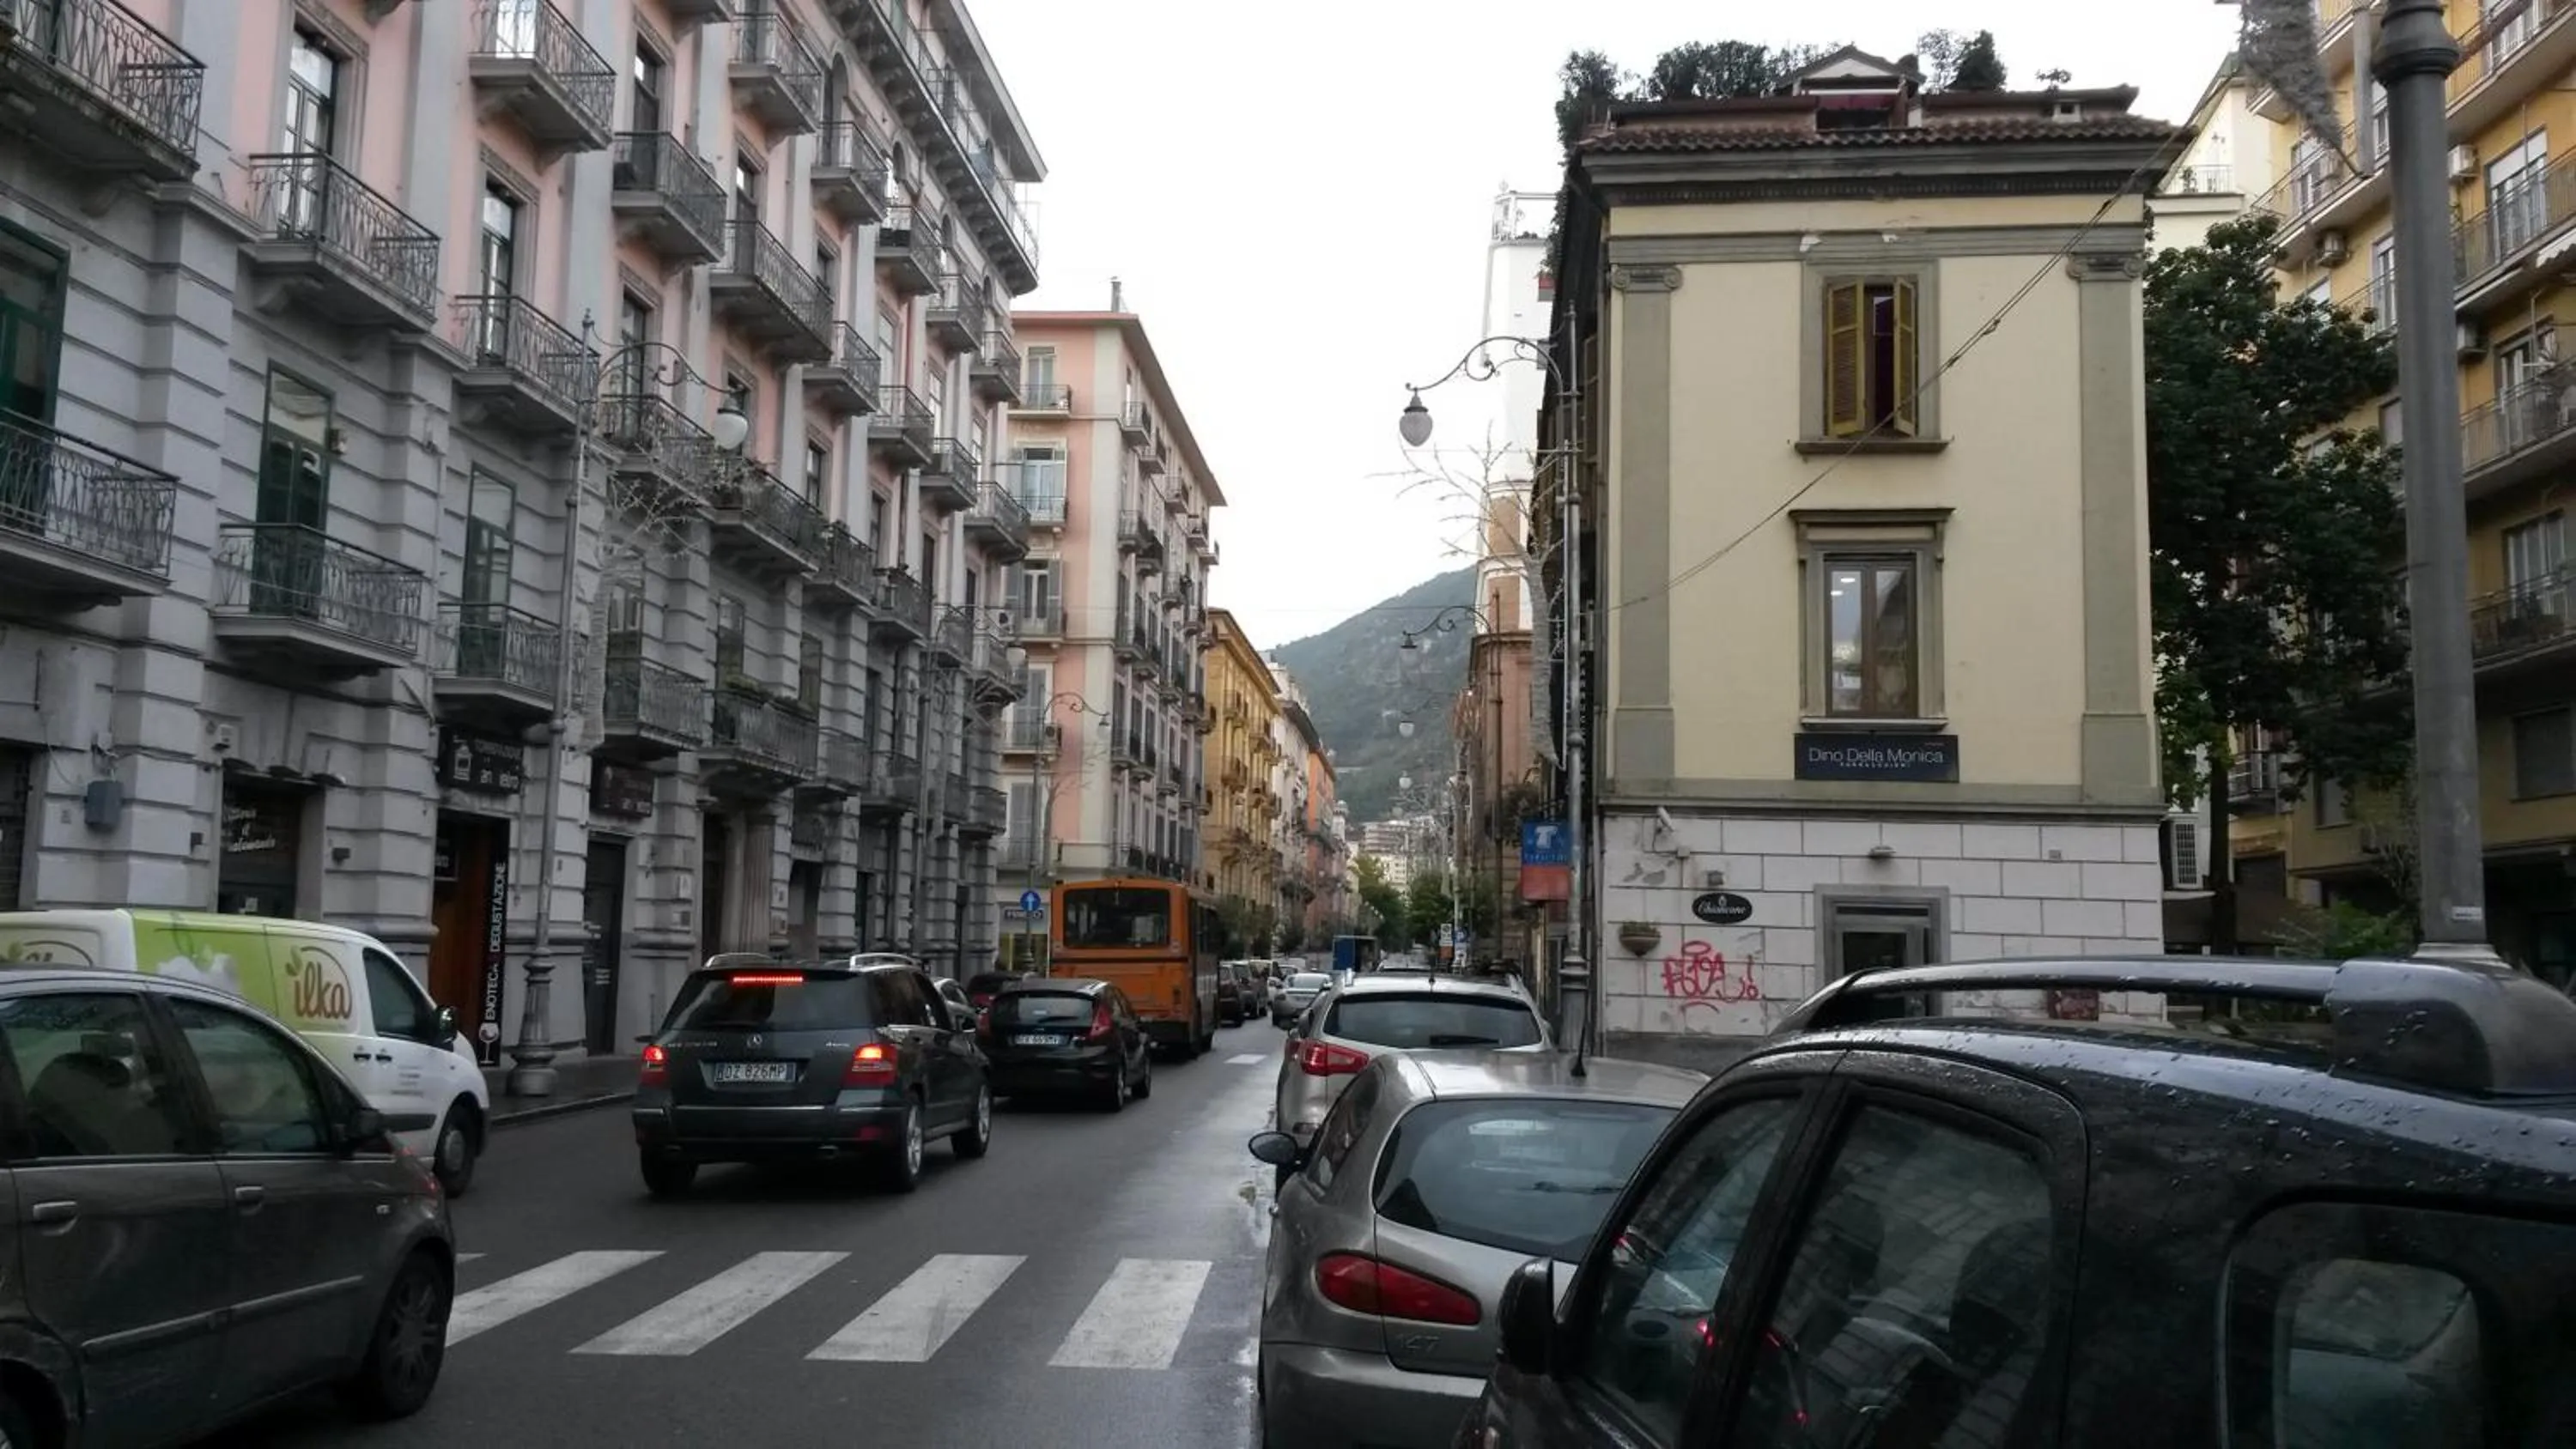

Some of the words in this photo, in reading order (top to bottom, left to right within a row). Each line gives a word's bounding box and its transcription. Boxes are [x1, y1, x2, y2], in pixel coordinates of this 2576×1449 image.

[1808, 747, 1844, 762] Dino
[1847, 748, 1884, 763] Della
[1888, 749, 1944, 764] Monica
[489, 861, 507, 953] DEGUSTAZIONE
[294, 960, 353, 1020] ilka
